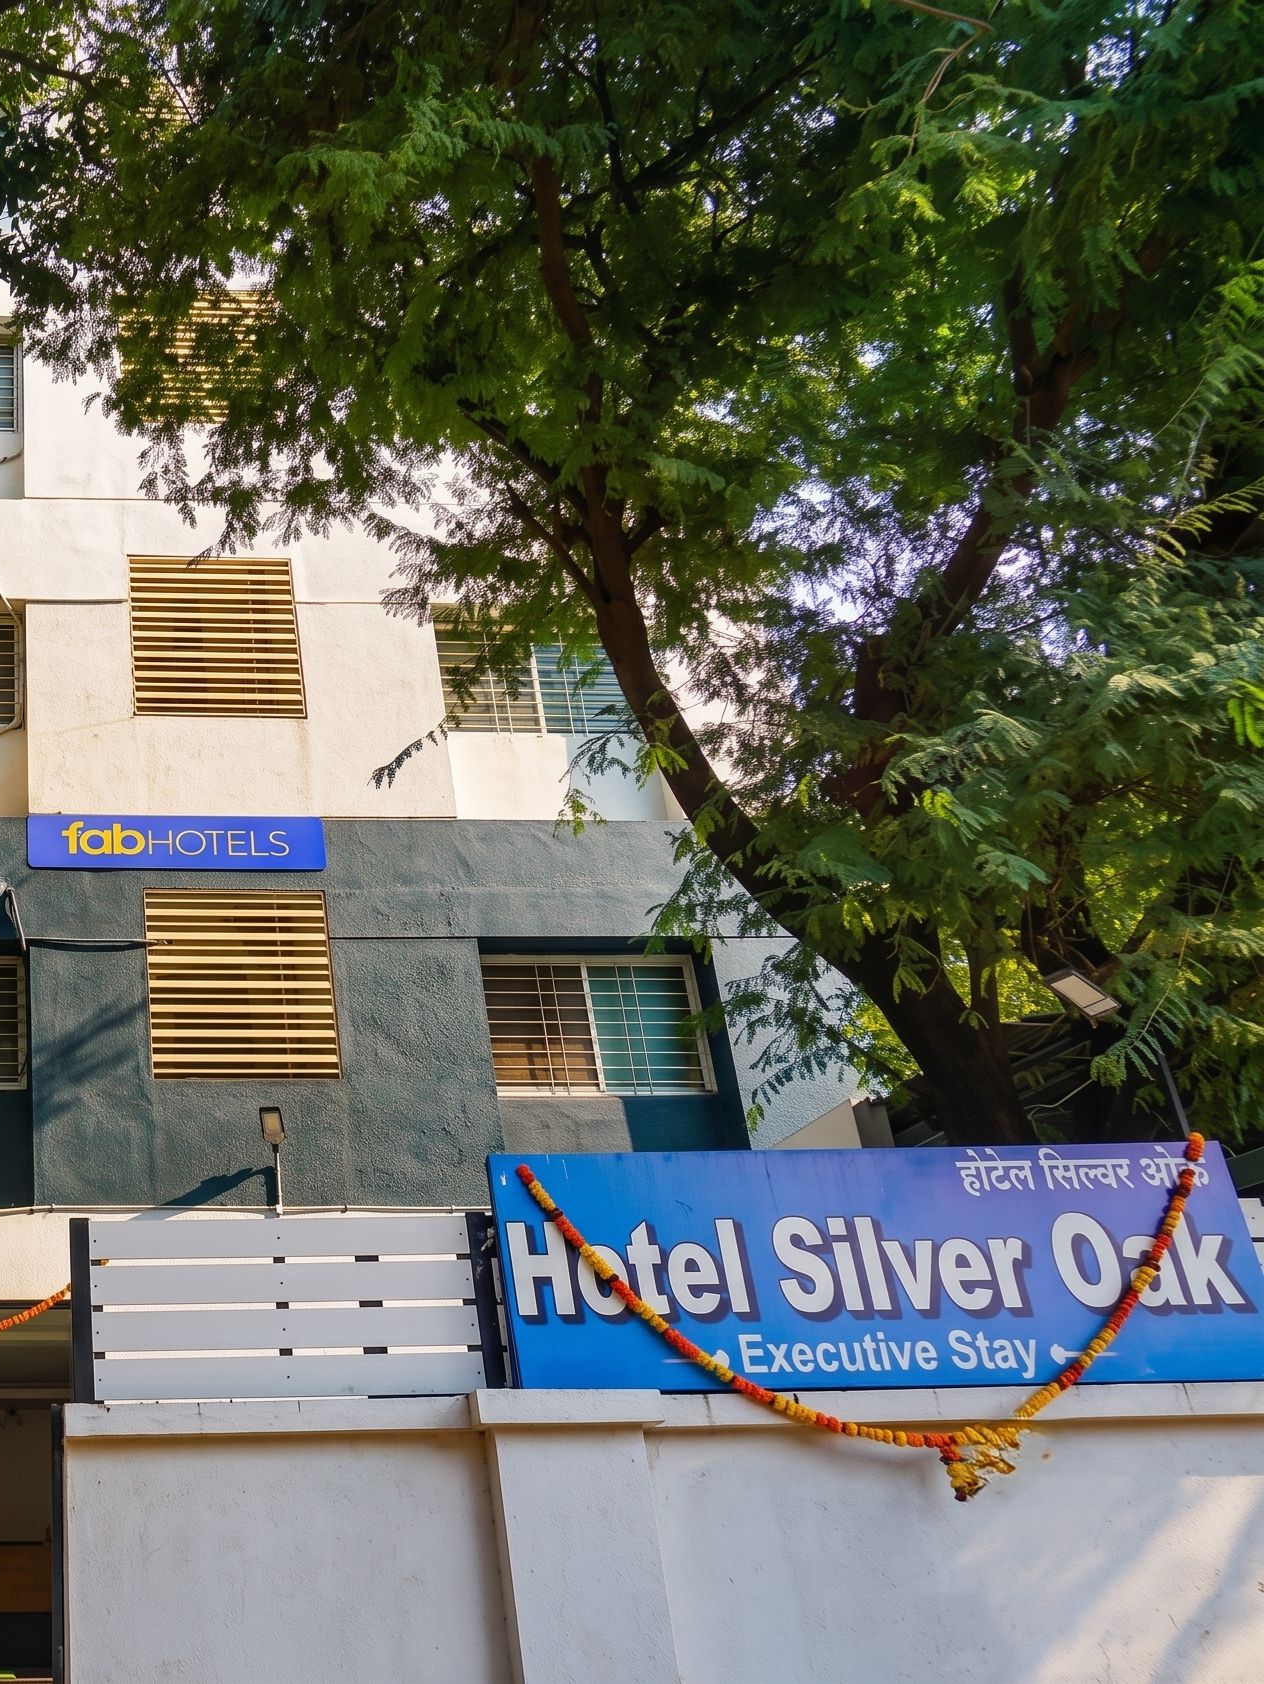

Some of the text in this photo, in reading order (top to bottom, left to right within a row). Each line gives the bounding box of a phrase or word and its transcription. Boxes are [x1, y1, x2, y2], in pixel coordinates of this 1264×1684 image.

[955, 1148, 1036, 1197] होटेल
[1038, 1148, 1135, 1191] सिल्वर
[505, 1211, 1247, 1316] Hotel Silver Oak
[738, 1329, 1037, 1379] Executive Stay
